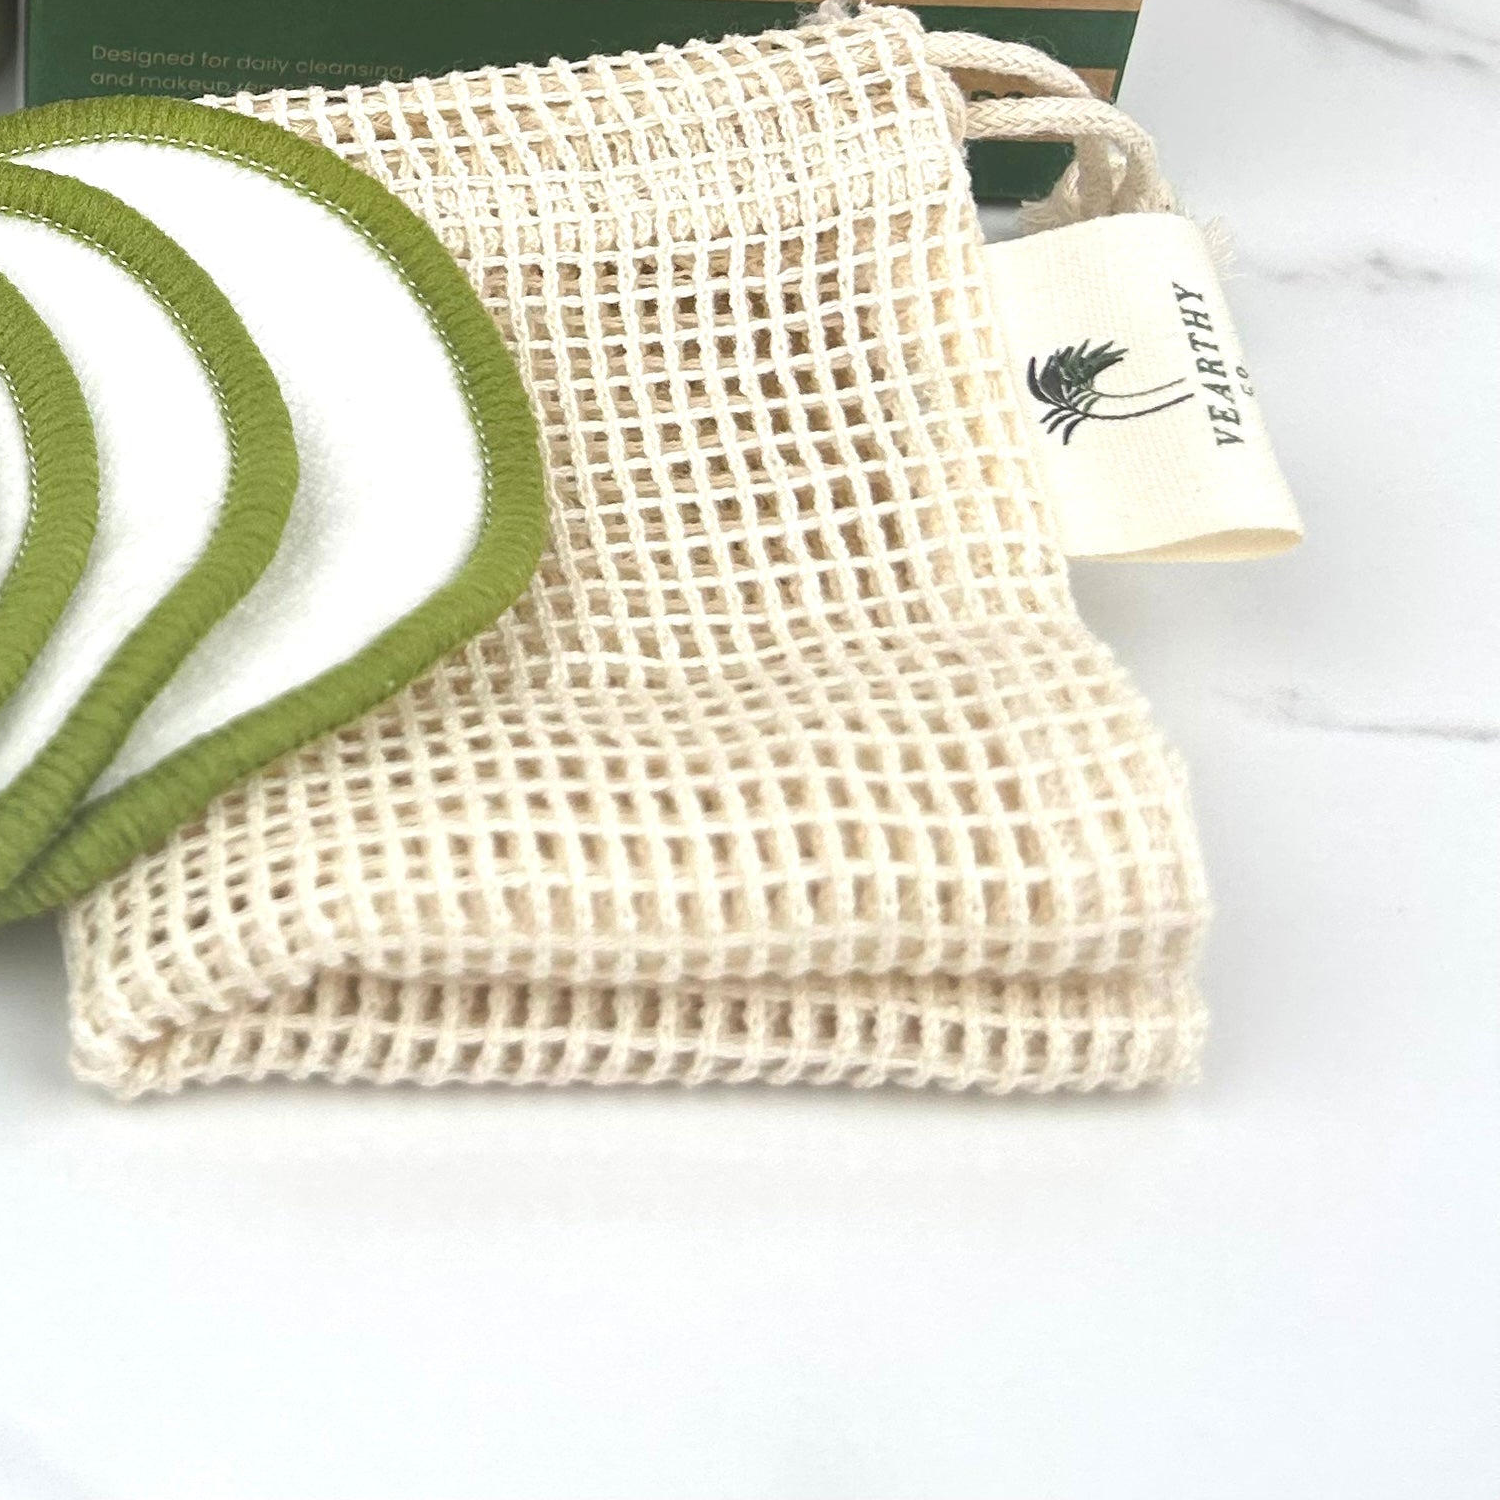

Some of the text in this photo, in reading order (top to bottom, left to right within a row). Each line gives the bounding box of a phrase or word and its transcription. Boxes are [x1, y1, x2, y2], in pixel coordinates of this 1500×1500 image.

[91, 45, 195, 68] Designed
[201, 51, 232, 69] for
[236, 55, 290, 76] daily
[90, 72, 134, 88] and
[1172, 281, 1245, 446] VEARTHY
